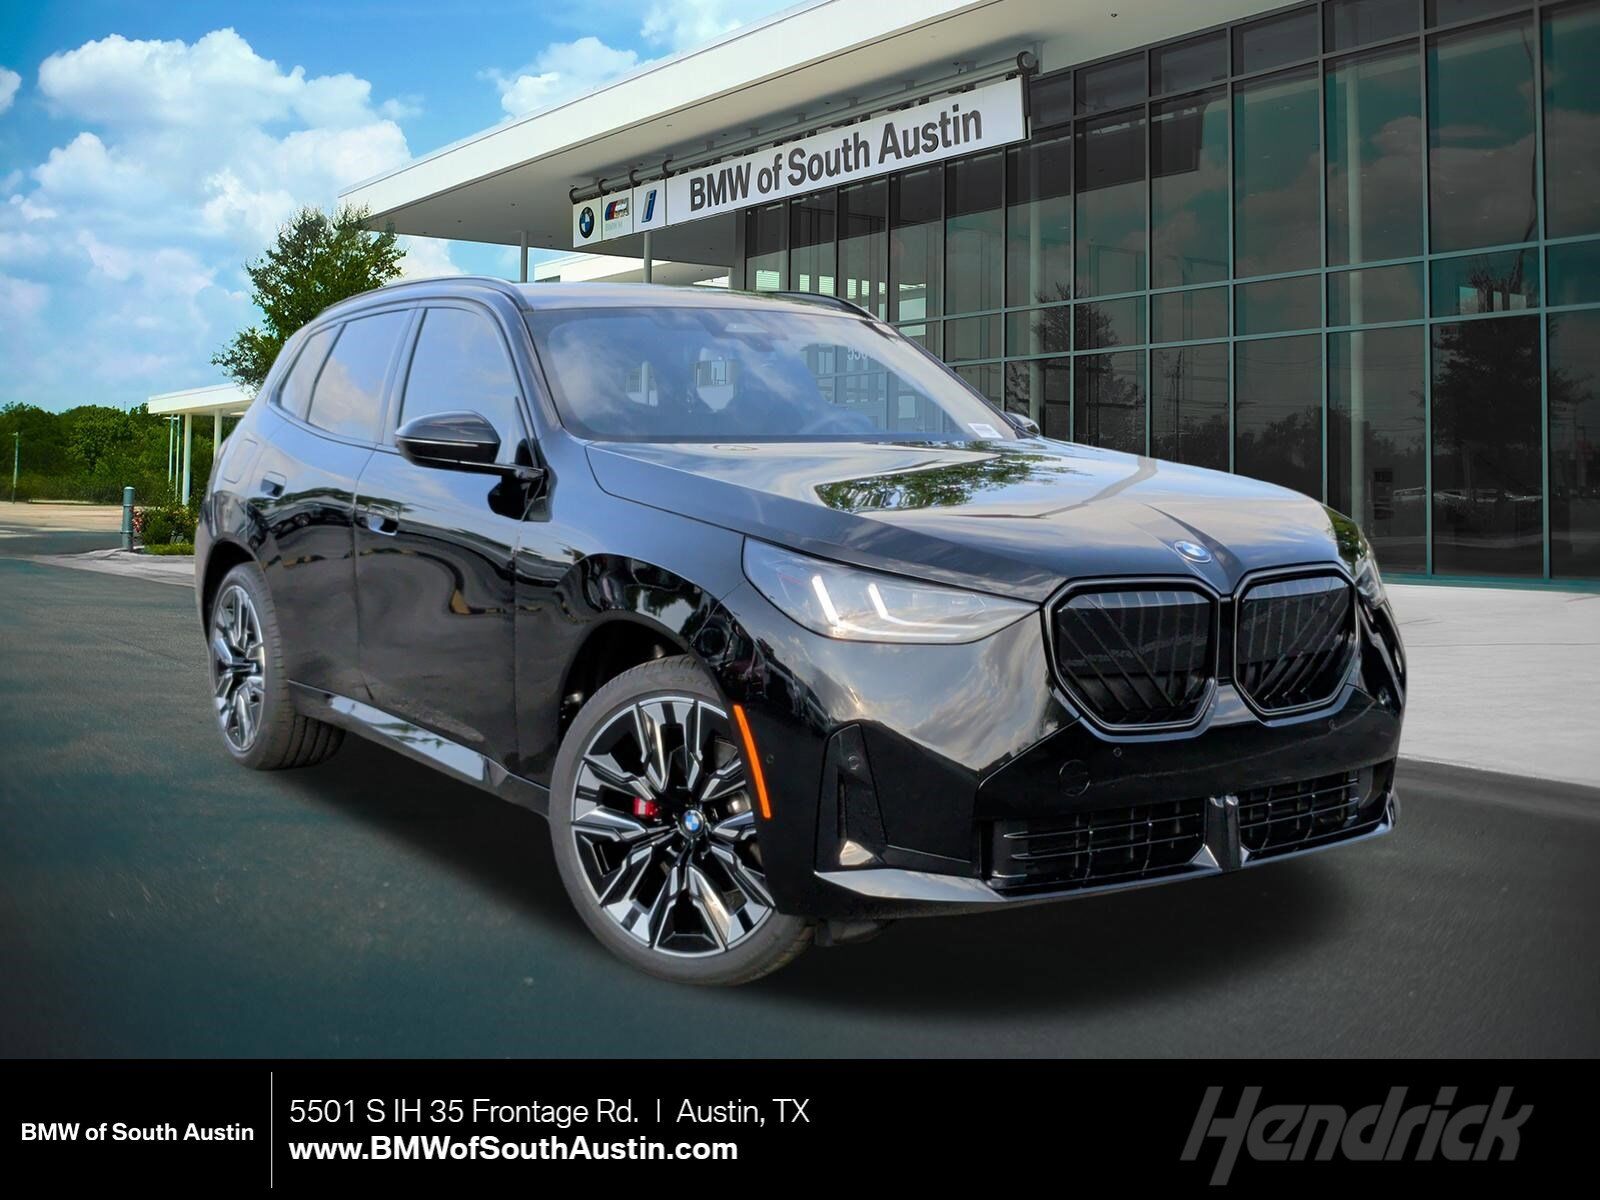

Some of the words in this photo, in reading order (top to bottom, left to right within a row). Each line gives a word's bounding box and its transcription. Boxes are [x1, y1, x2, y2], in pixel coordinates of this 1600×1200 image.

[690, 162, 752, 212] BMW
[757, 153, 783, 194] of
[787, 131, 871, 187] South
[878, 103, 983, 165] Austin
